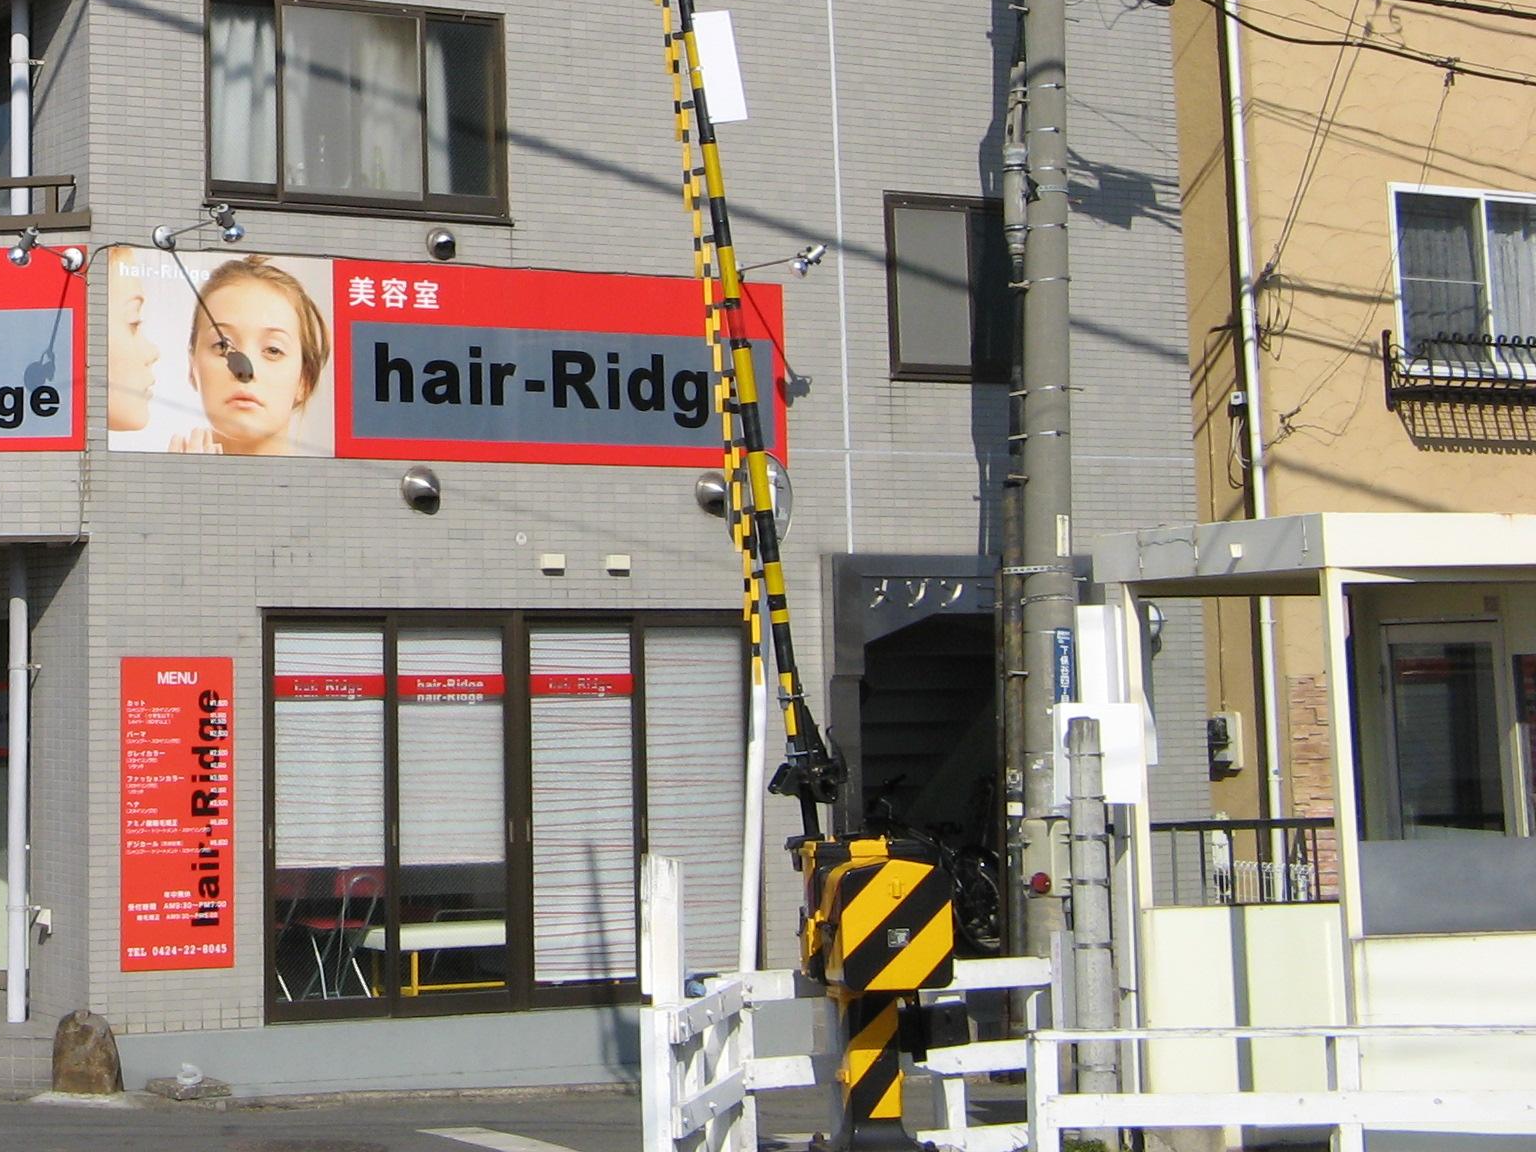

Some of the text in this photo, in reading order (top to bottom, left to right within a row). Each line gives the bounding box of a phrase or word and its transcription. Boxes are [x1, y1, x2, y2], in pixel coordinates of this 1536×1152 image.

[349, 276, 441, 311] 美容室
[373, 343, 741, 429] hair-Ridg
[157, 671, 198, 686] MENU
[127, 944, 228, 957] TEL 0424-22-8045
